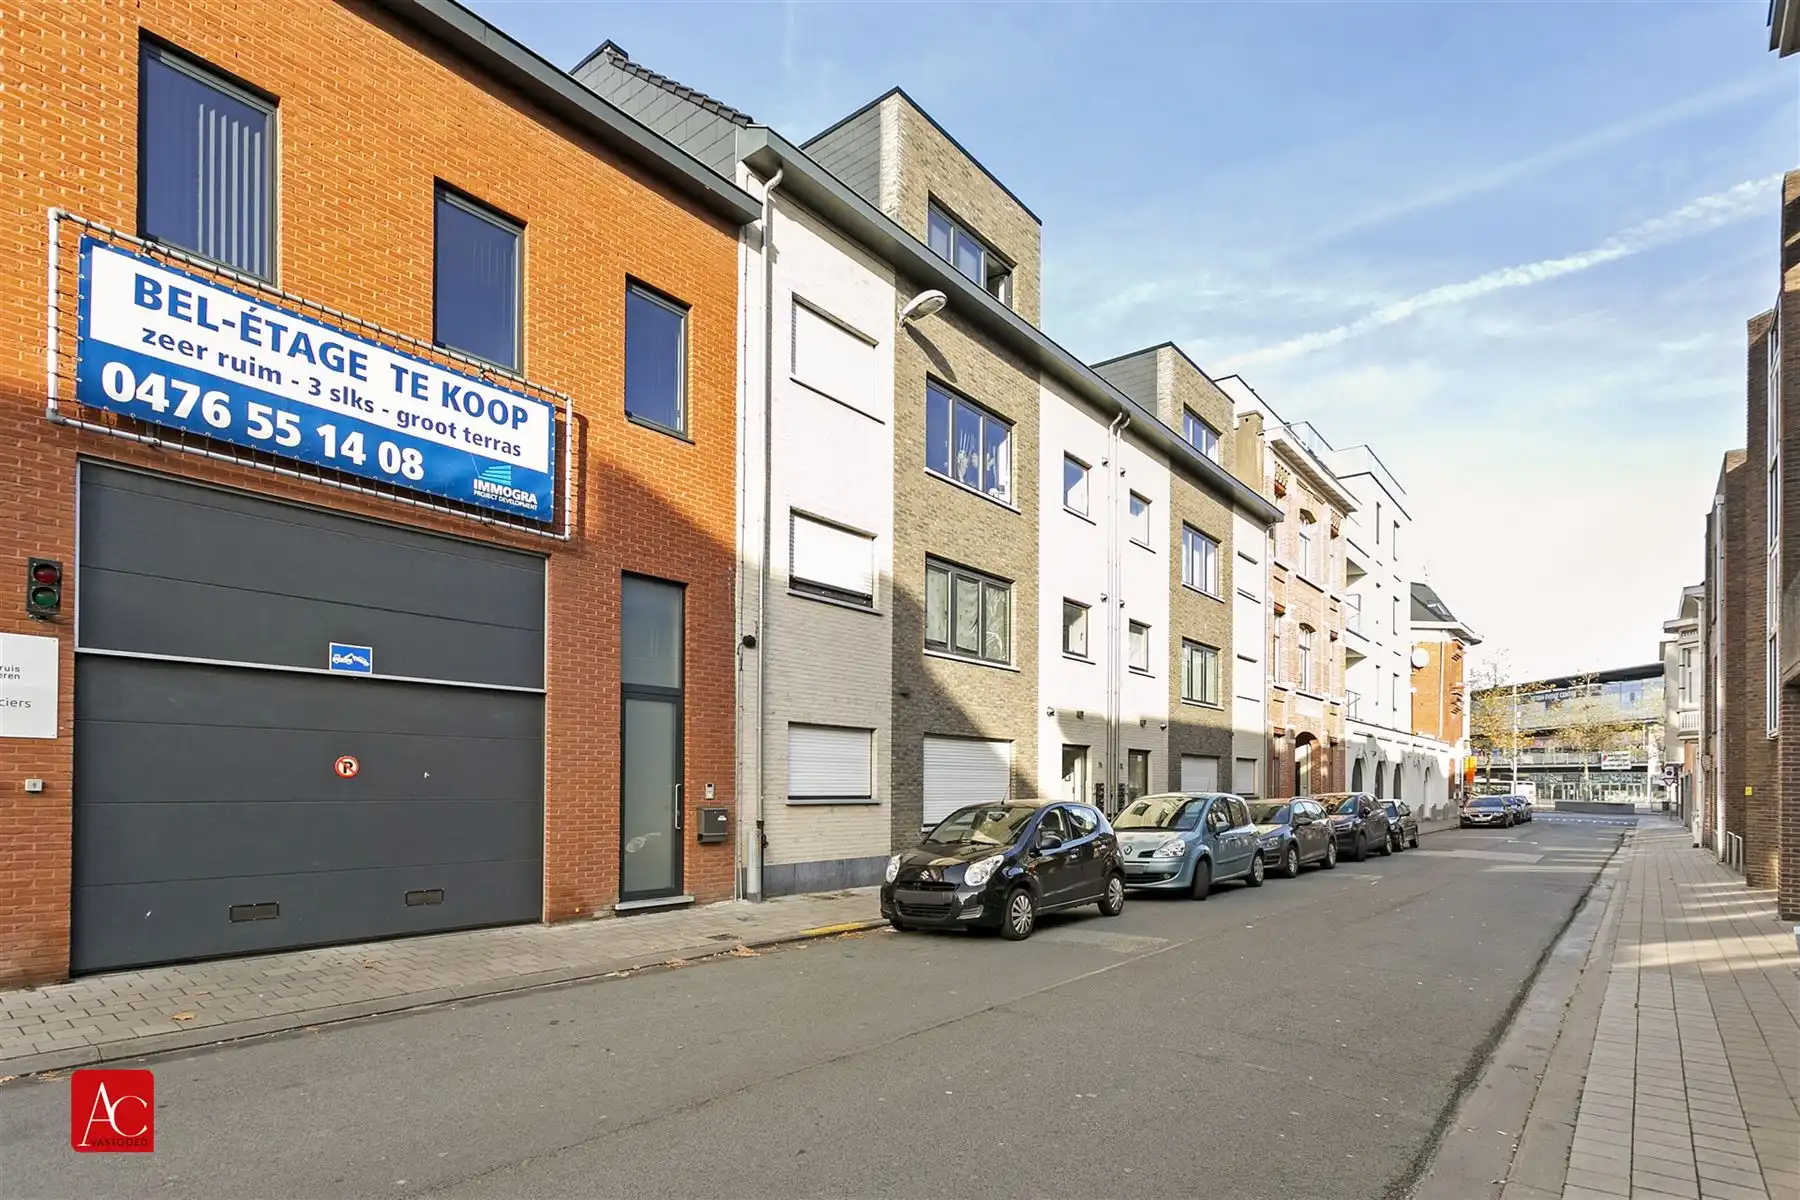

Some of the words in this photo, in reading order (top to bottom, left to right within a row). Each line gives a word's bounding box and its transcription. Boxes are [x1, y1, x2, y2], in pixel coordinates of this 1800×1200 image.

[134, 272, 368, 382] BEL-ÉTAGE
[390, 363, 429, 402] TE
[441, 381, 529, 430] KOOP
[142, 327, 208, 360] zeer
[218, 351, 282, 385] ruim
[308, 377, 322, 396] 3
[330, 385, 375, 414] slks
[397, 409, 457, 439] groot
[463, 426, 521, 457] terras
[101, 361, 232, 429] 0476
[247, 401, 301, 448] 55
[316, 423, 367, 466] 14
[378, 440, 425, 481] 08
[473, 478, 538, 505] IMMOGRA
[473, 489, 498, 501] PROJECT
[498, 495, 538, 511] DEVELOPMENT
